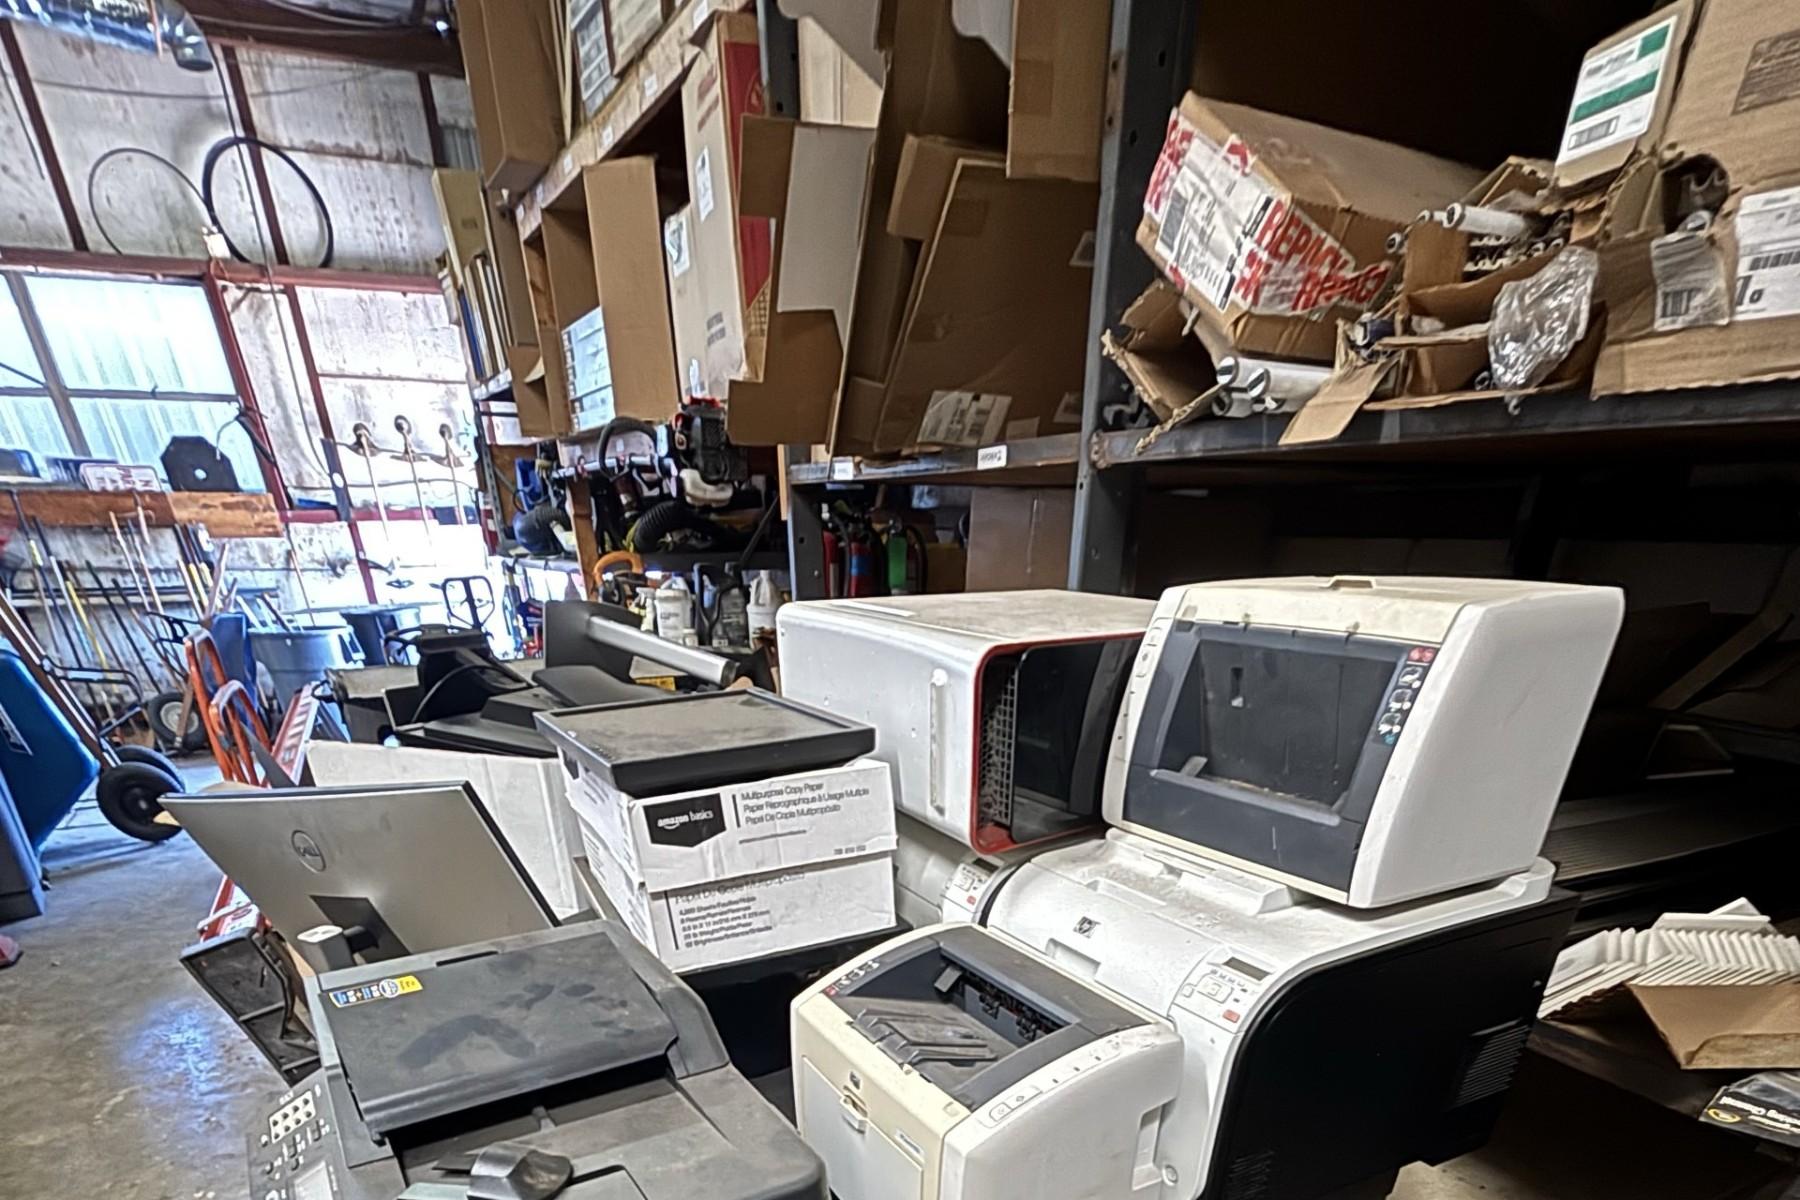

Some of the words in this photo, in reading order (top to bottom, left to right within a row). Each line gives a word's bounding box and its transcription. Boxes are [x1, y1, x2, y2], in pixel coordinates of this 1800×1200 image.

[740, 788, 784, 801] Multipurpose
[784, 784, 803, 795] Copy
[803, 782, 824, 793] Paper
[657, 814, 690, 829] amazon
[689, 810, 715, 822] basics
[775, 809, 796, 820] Copia
